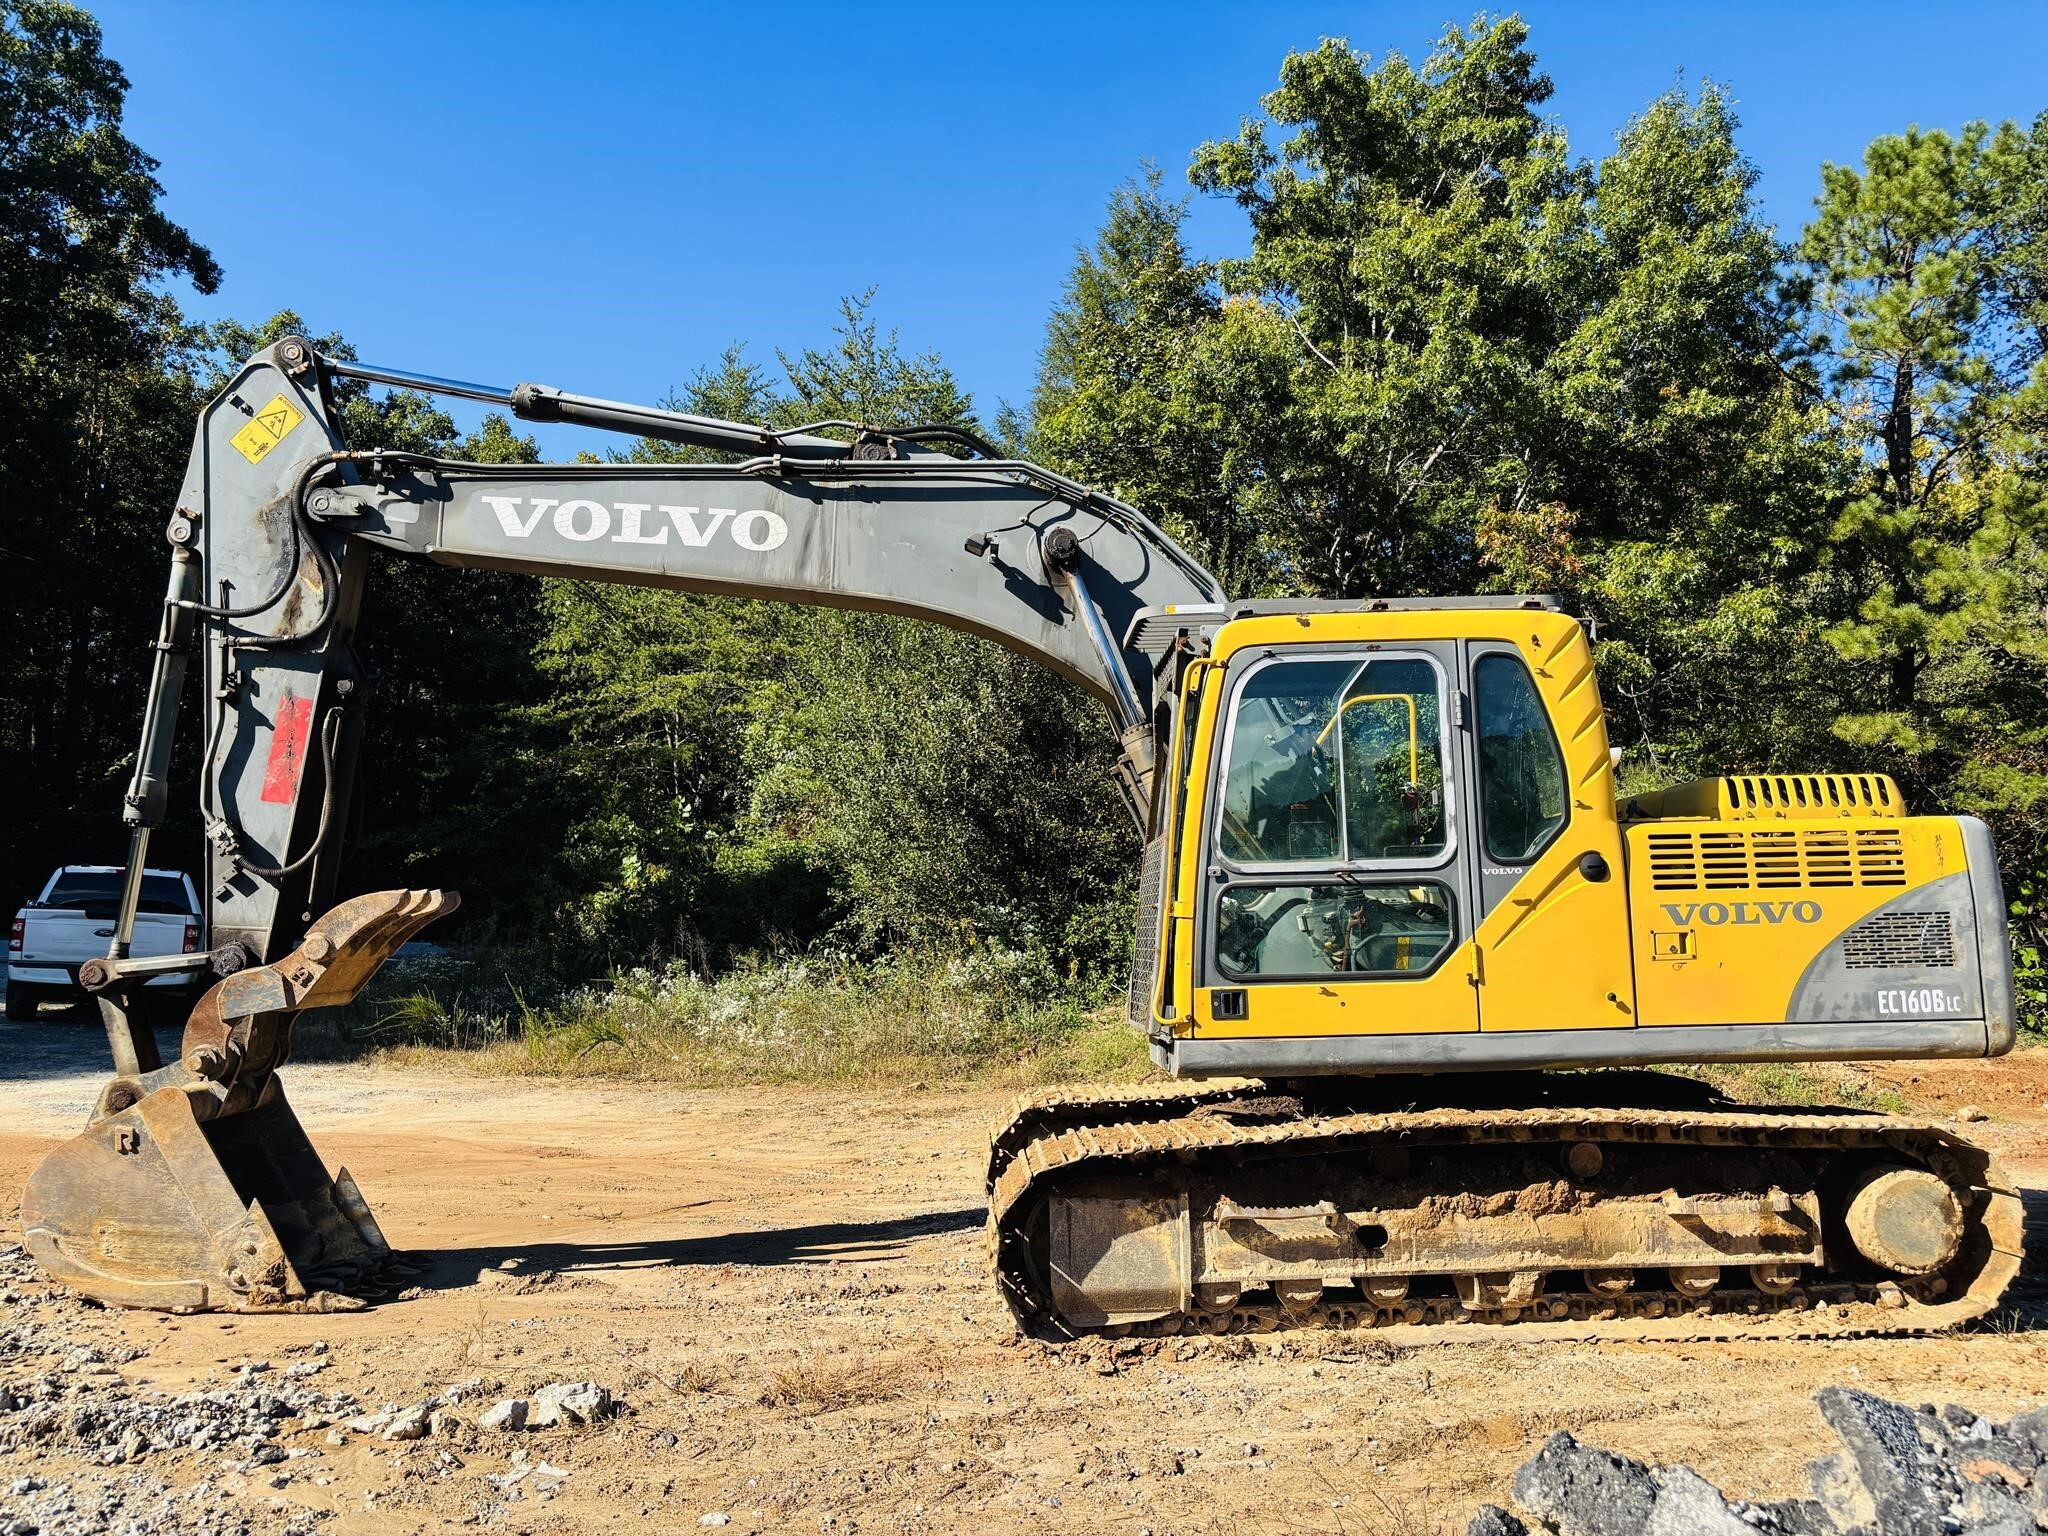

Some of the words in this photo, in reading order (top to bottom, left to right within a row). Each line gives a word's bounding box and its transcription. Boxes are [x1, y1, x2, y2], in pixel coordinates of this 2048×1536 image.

[481, 496, 788, 551] VOLVO
[1481, 867, 1523, 875] VOLVO
[1660, 900, 1822, 925] VOLVO
[115, 1125, 135, 1154] R
